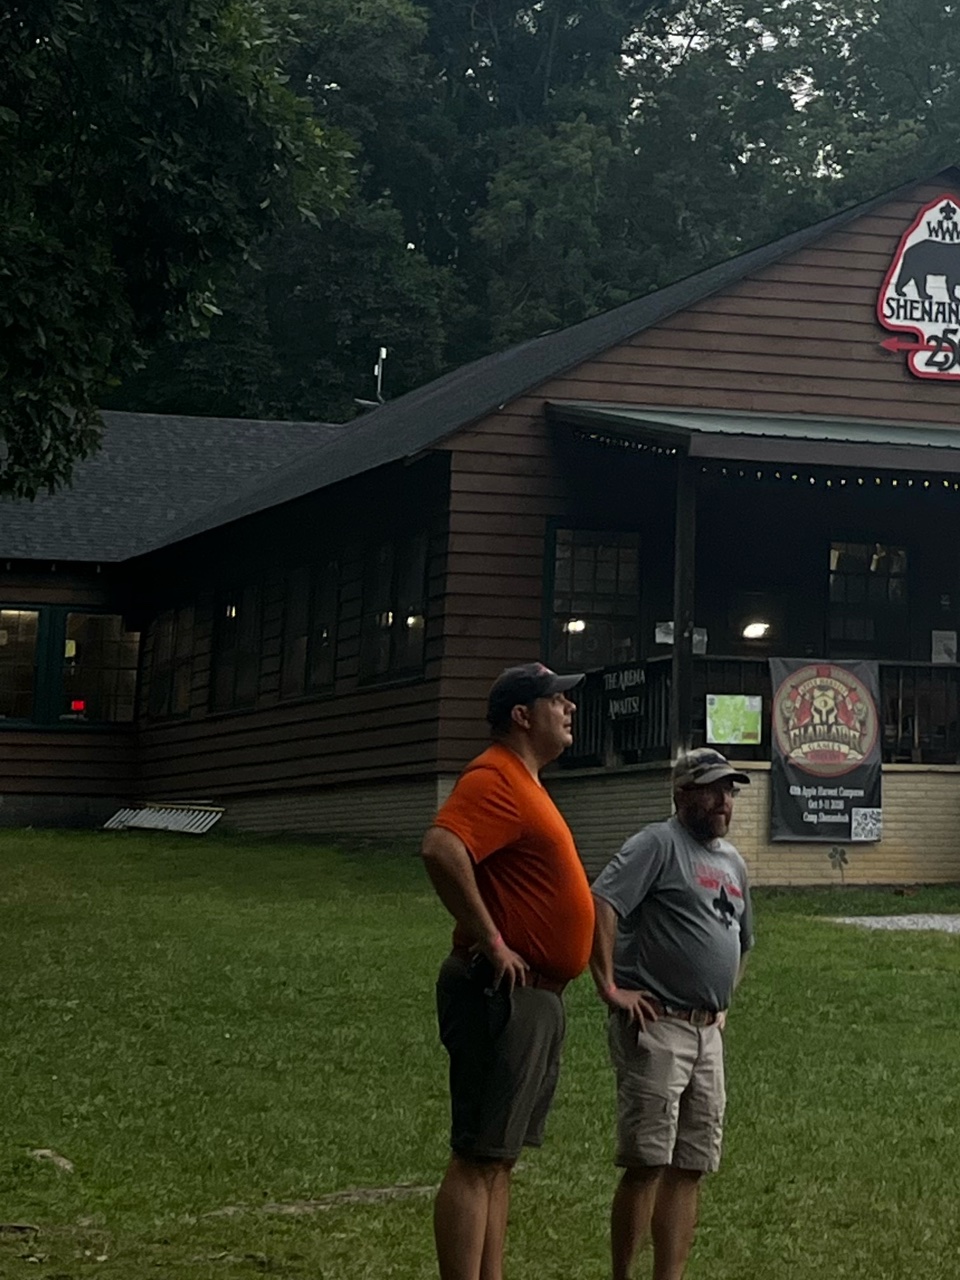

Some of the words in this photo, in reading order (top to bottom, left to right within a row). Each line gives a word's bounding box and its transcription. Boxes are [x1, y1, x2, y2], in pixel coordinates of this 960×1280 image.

[603, 672, 617, 691] THE
[617, 668, 646, 691] ARENA
[789, 723, 864, 754] GLADIATOR
[806, 742, 842, 752] GAMES
